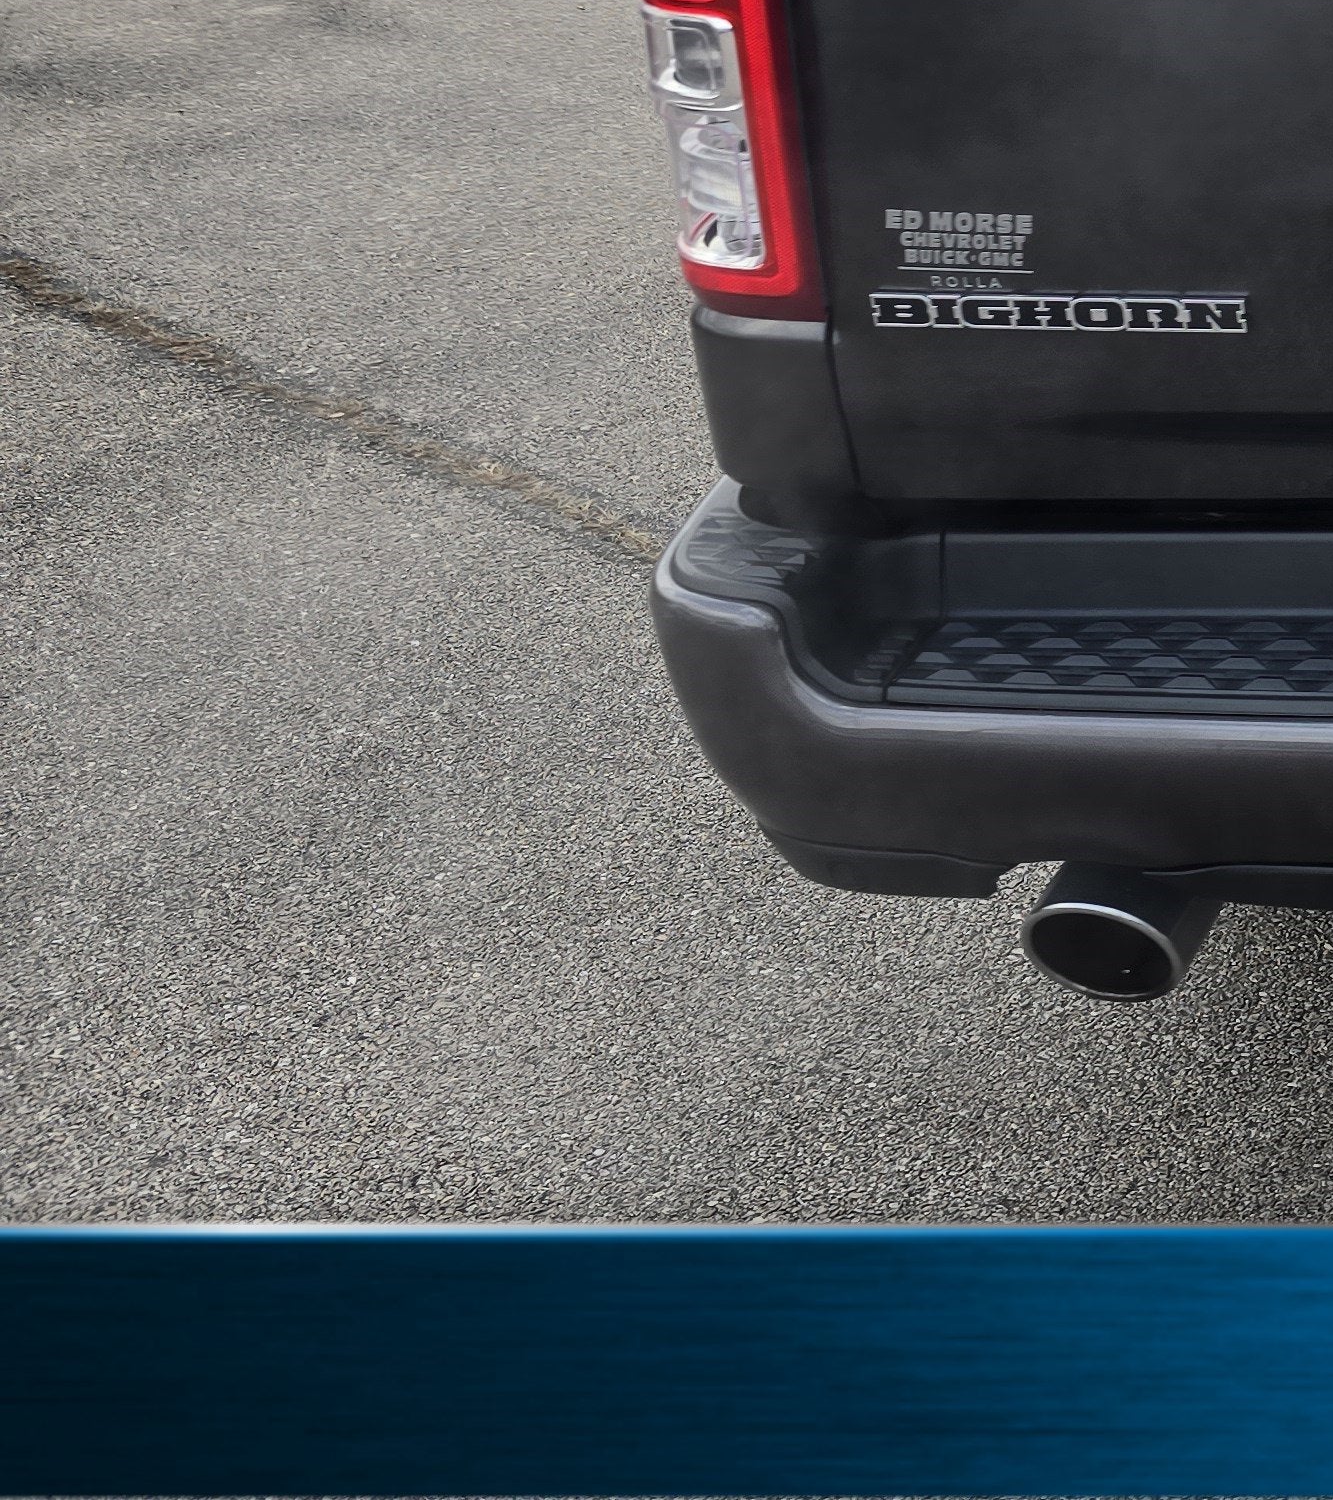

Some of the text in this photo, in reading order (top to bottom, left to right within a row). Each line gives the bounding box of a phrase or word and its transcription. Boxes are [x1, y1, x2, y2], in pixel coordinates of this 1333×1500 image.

[884, 208, 1034, 235] ED MORSE
[900, 231, 1027, 251] CHEVROLET
[929, 274, 1003, 289] ROLLA
